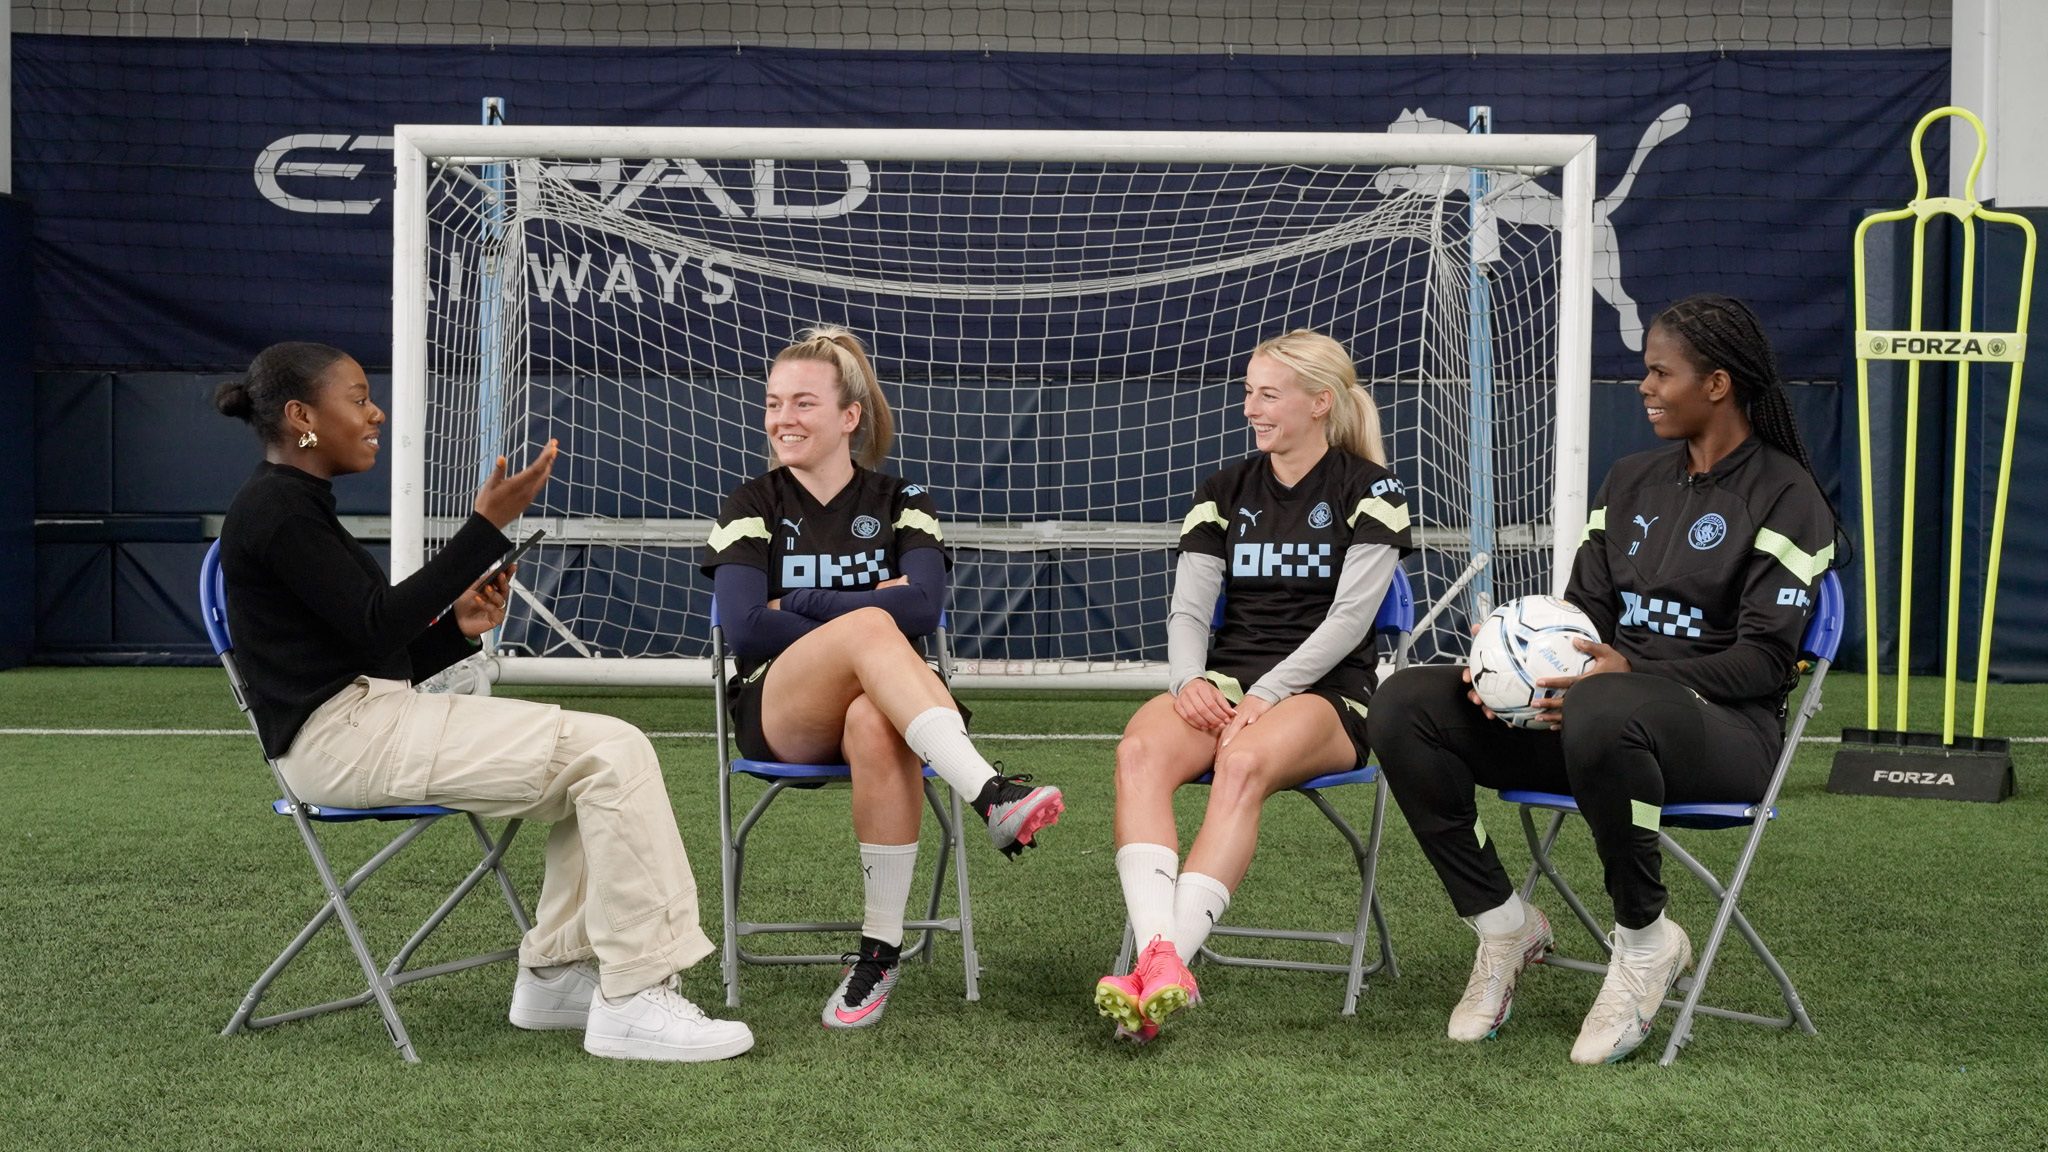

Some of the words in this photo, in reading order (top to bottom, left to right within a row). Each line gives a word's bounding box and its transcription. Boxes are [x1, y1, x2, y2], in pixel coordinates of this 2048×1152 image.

[255, 133, 871, 216] EHAD
[391, 251, 734, 305] IWAYS
[1892, 338, 1983, 355] FORZA
[1239, 523, 1247, 537] 9
[786, 536, 795, 550] 11
[1628, 541, 1640, 555] 21
[1232, 542, 1331, 577] OKX
[781, 549, 890, 588] OKX
[1873, 770, 1955, 786] FORZA
